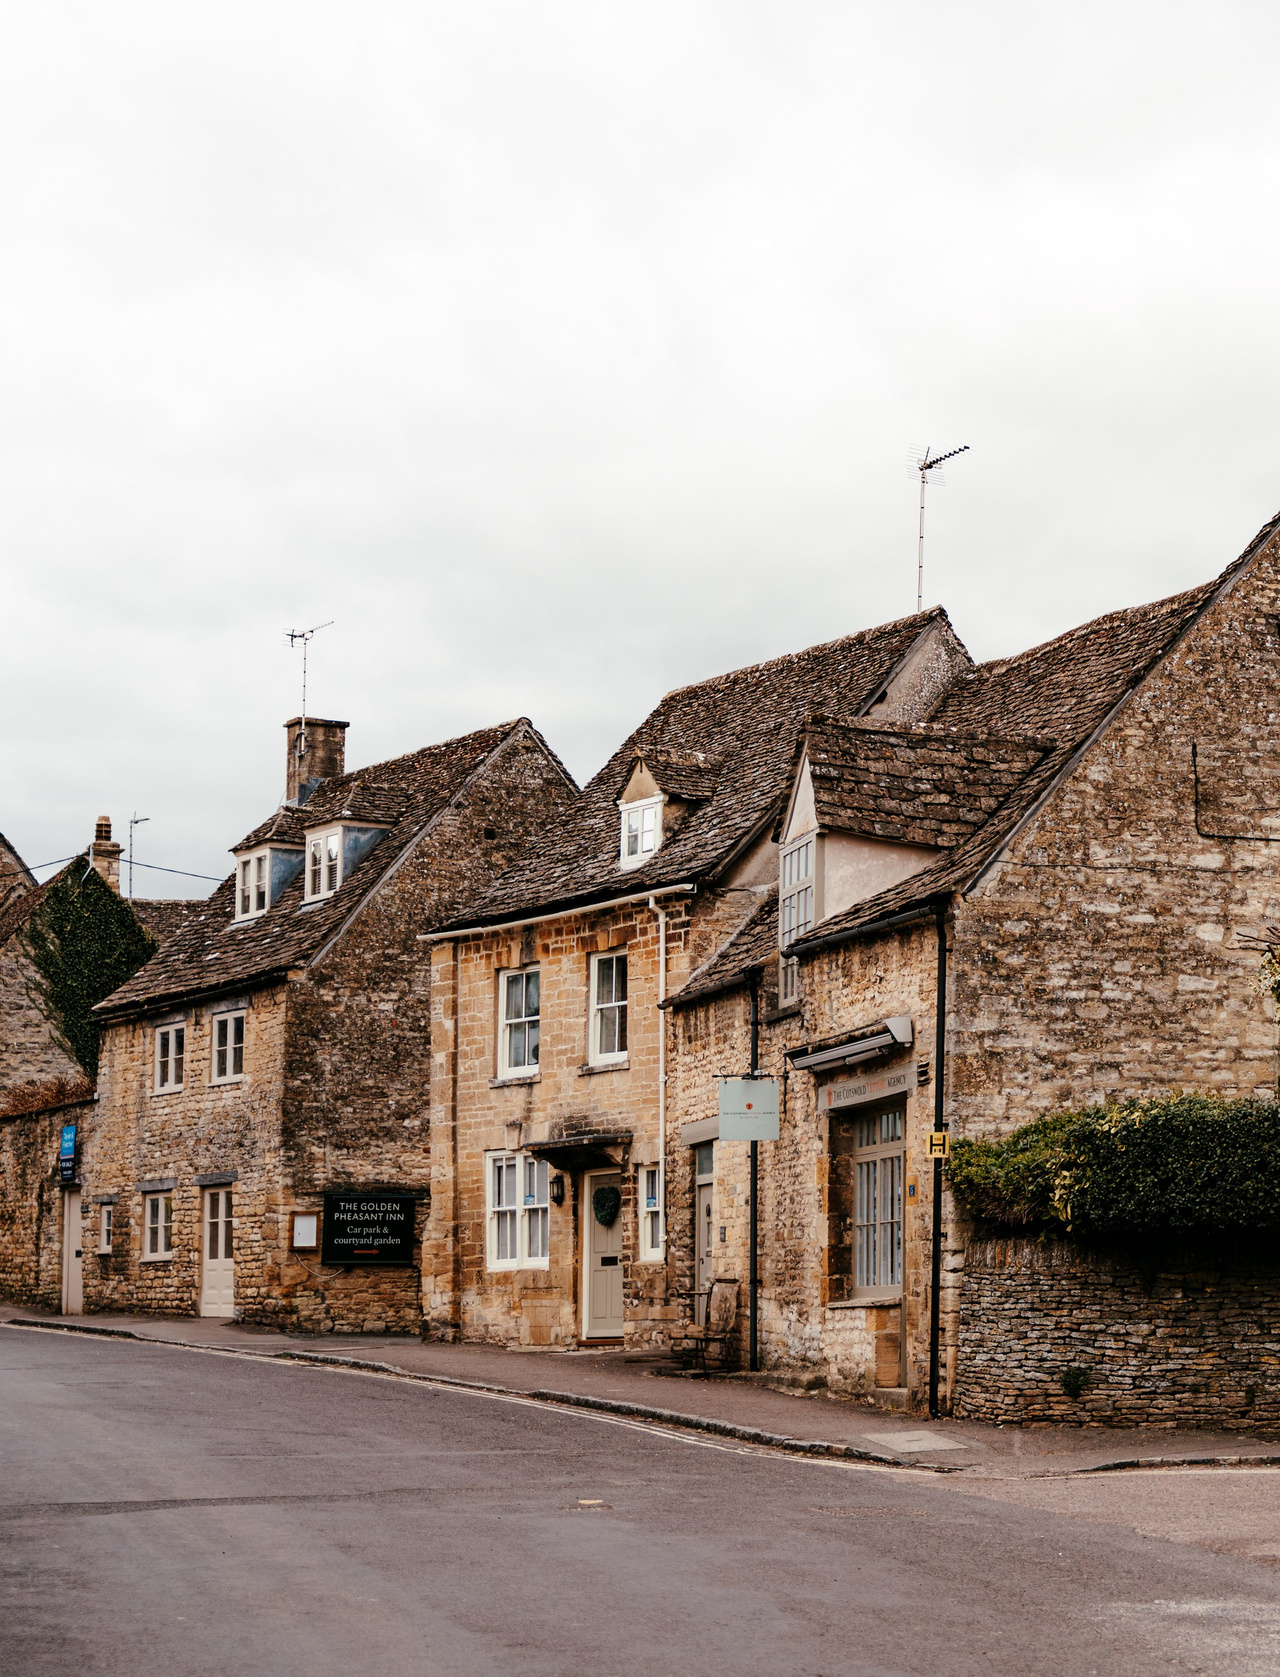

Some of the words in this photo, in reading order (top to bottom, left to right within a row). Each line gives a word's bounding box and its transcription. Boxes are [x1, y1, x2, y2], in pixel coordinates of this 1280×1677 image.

[833, 1090, 842, 1102] THE
[842, 1085, 867, 1099] COTSWOLD
[887, 1074, 907, 1088] AGENCY
[930, 1135, 946, 1155] H
[339, 1202, 358, 1211] THE
[360, 1202, 400, 1211] GOLDEN
[334, 1213, 383, 1221] PHEASANT
[386, 1213, 405, 1221] INN
[347, 1226, 361, 1234] Car
[363, 1225, 381, 1235] park
[382, 1226, 389, 1234] &
[334, 1236, 372, 1246] courtyard
[373, 1236, 401, 1246] garden
